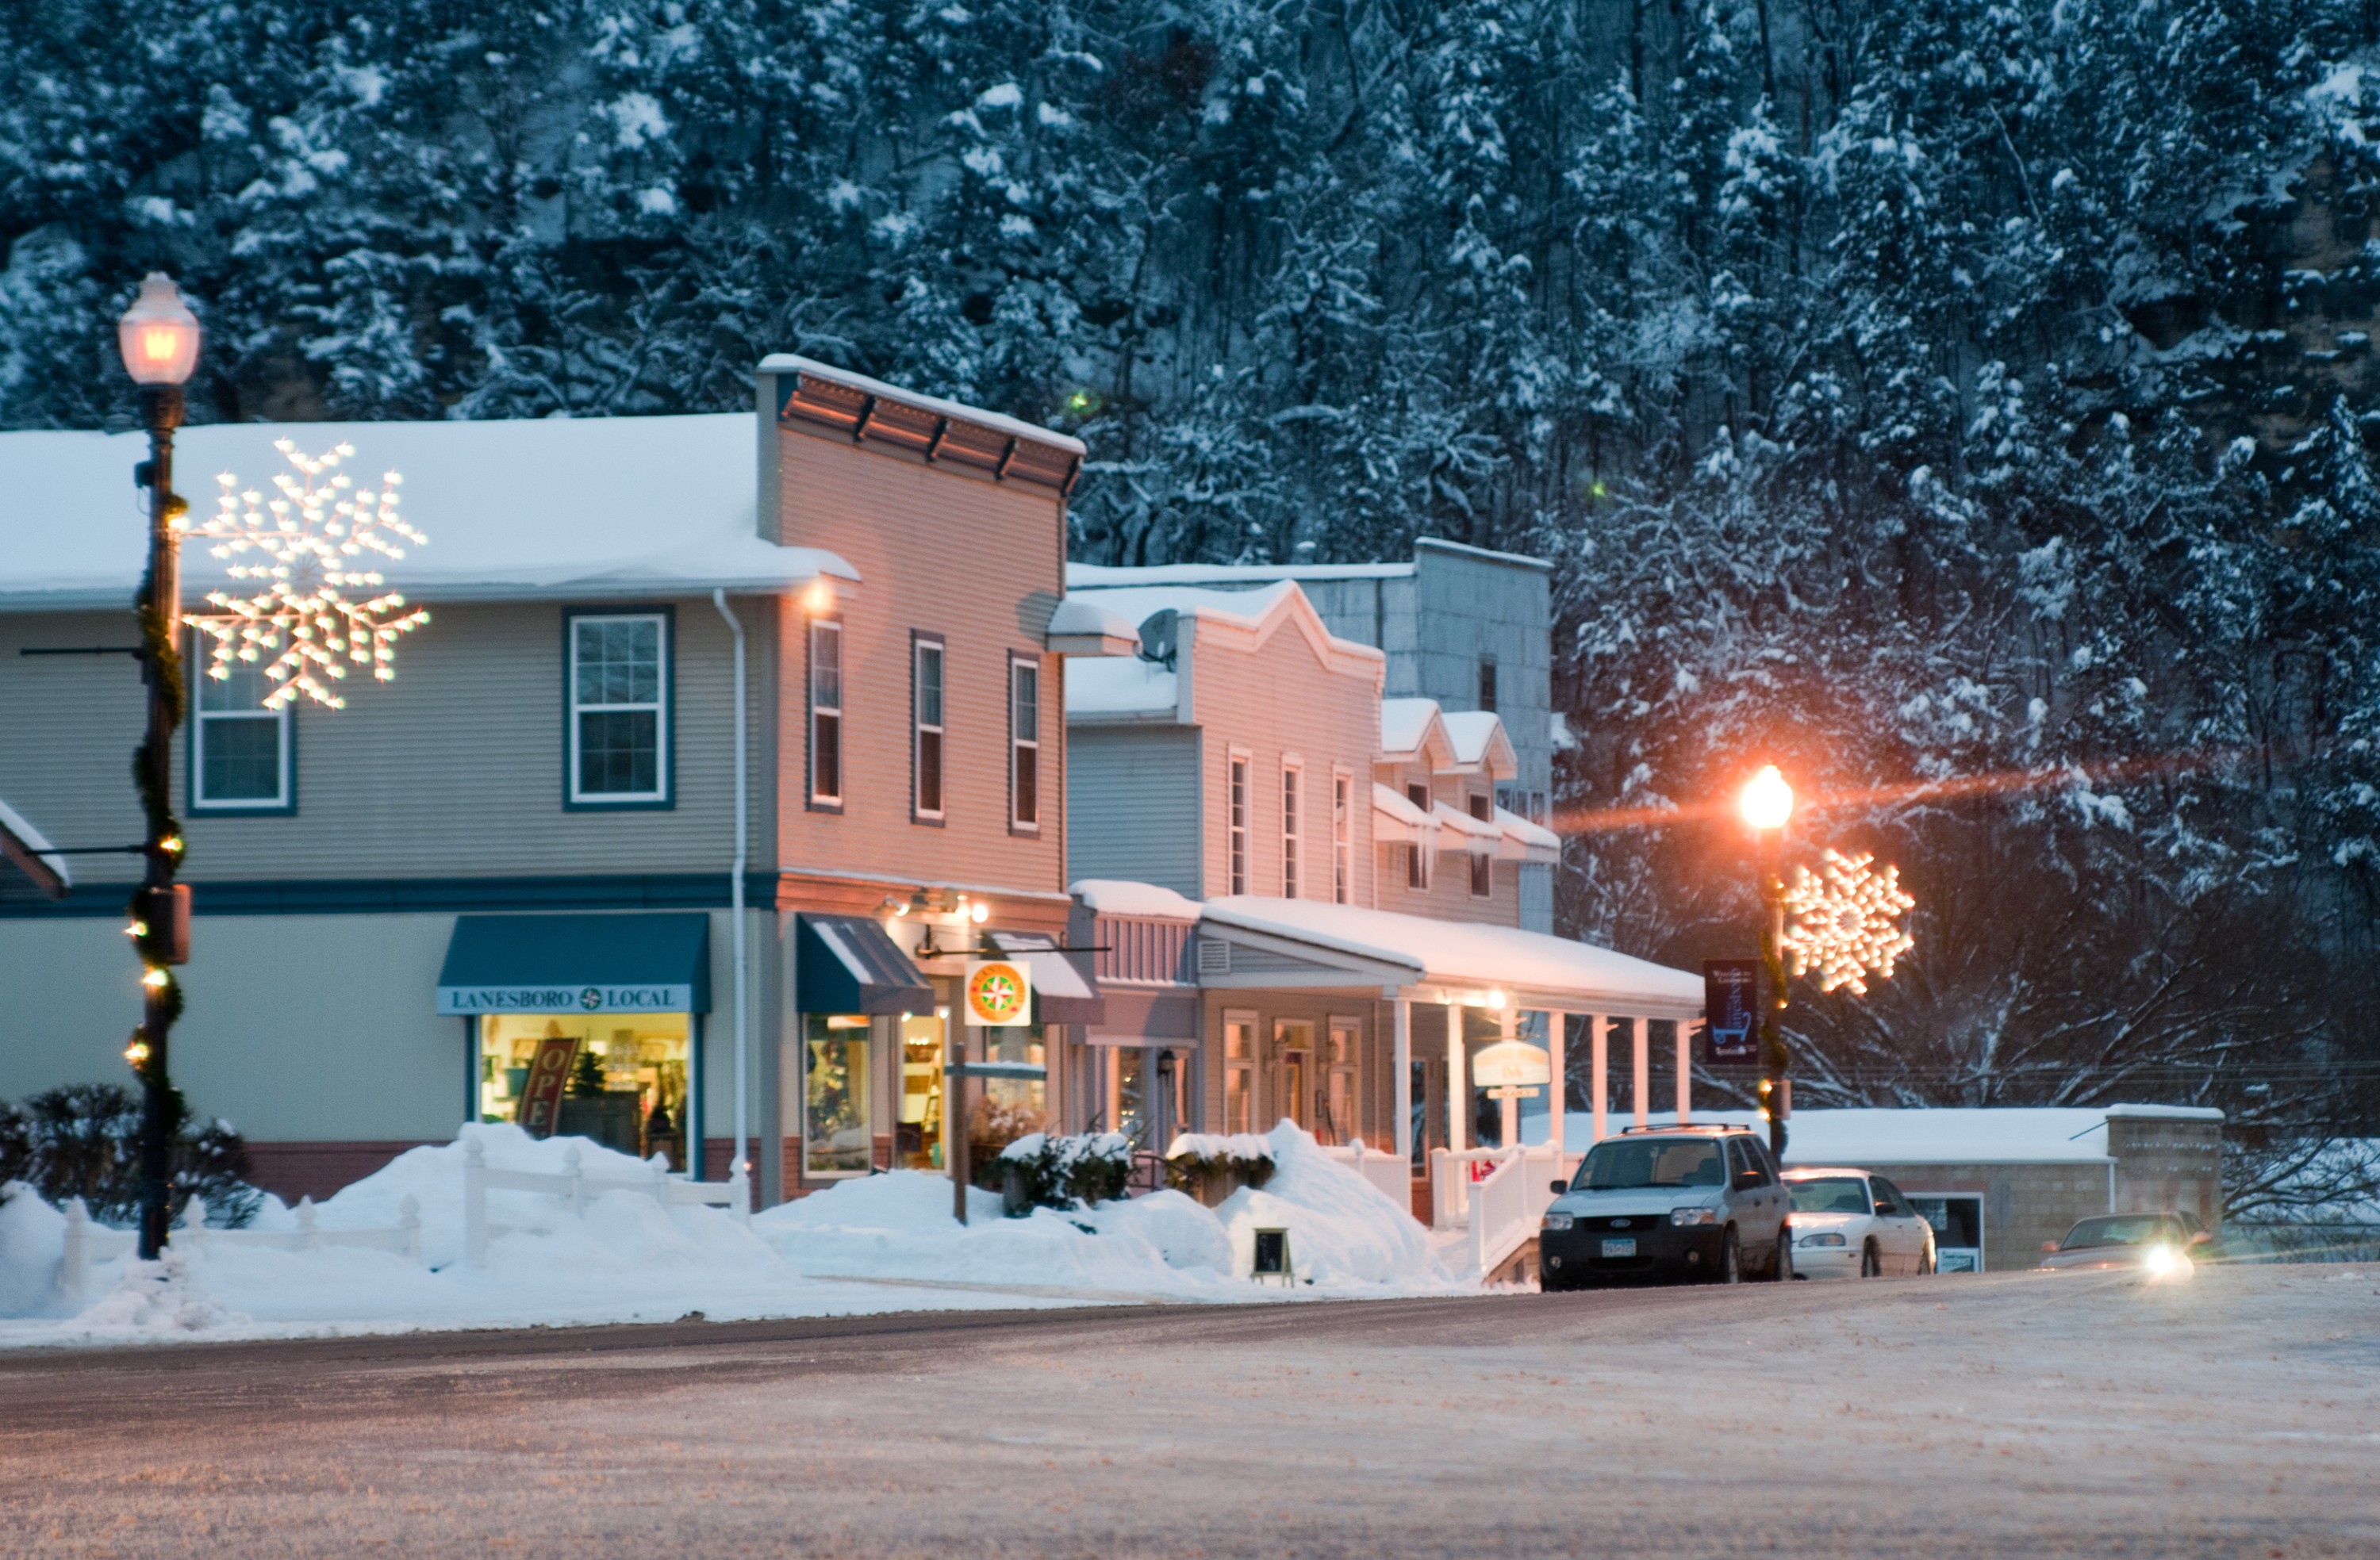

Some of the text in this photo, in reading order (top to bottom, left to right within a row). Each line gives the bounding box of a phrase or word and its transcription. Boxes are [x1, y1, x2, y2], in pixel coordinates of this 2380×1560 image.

[451, 989, 674, 1008] LANESBORO LOCAL
[528, 1048, 566, 1137] OPE
